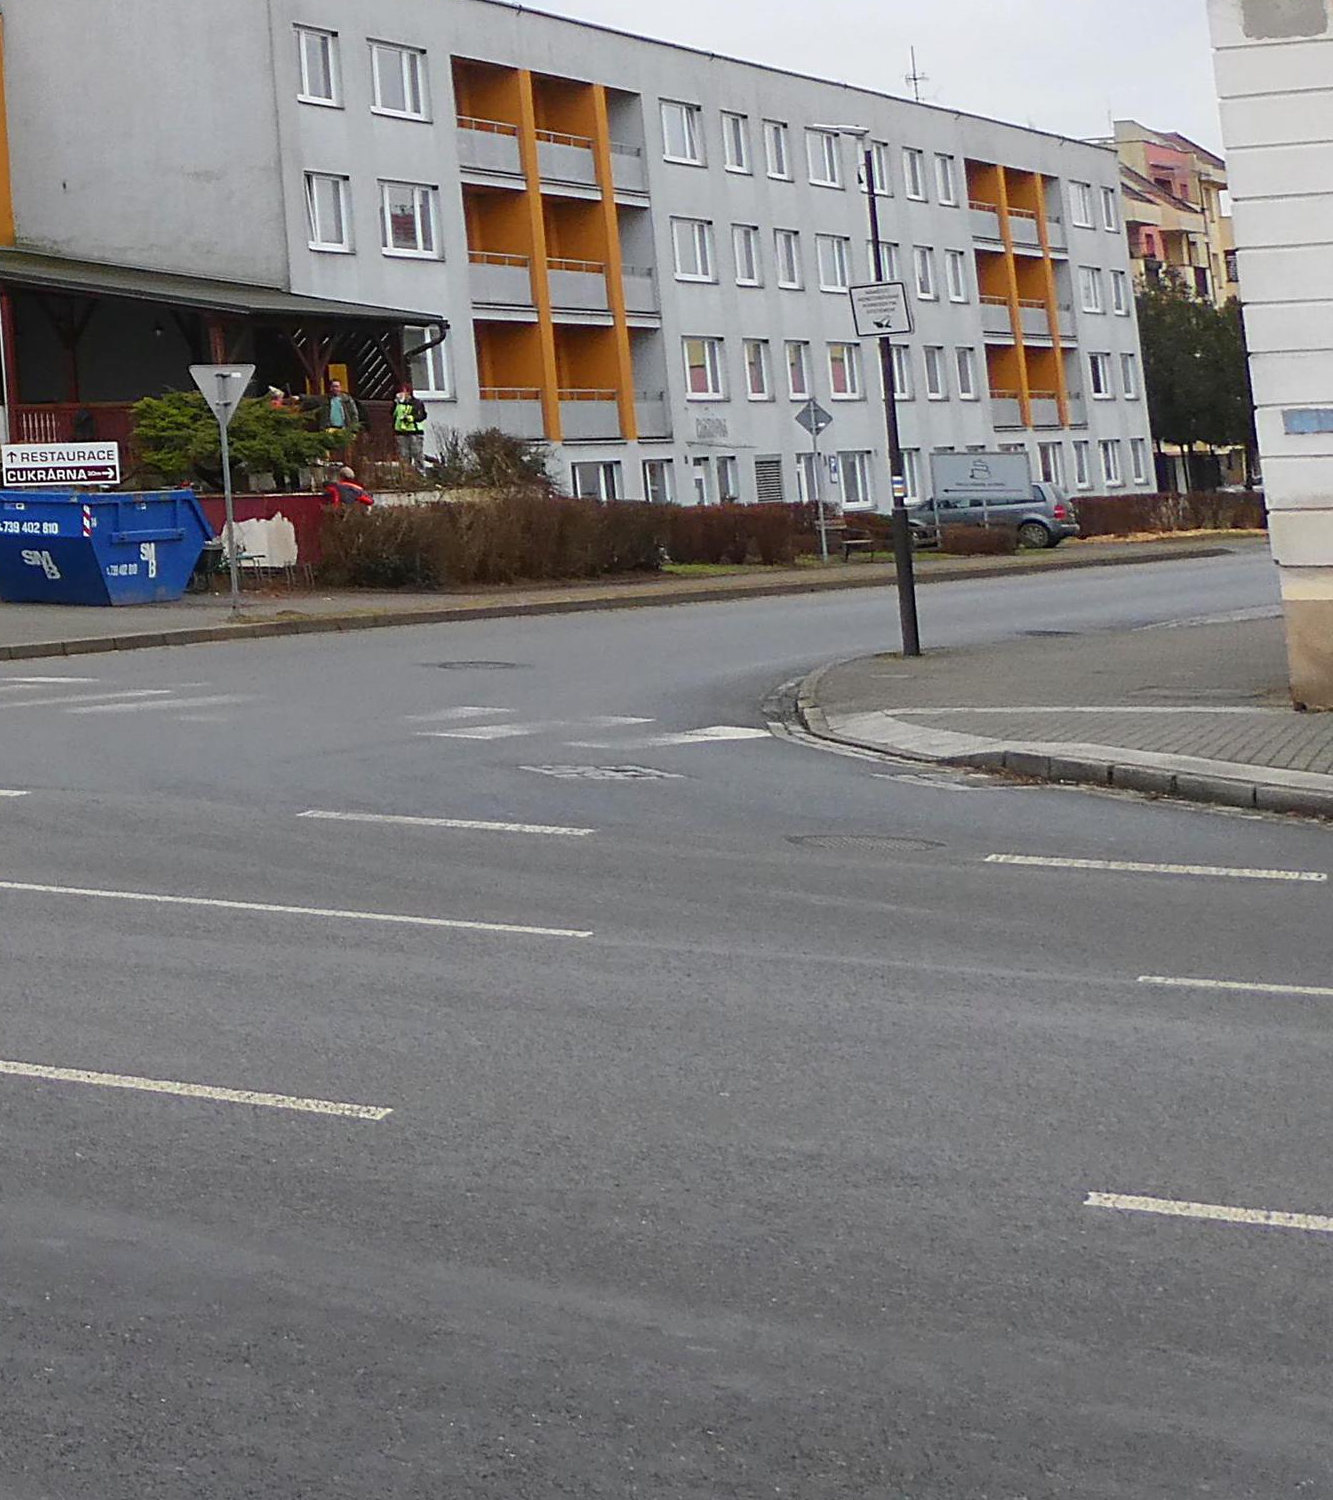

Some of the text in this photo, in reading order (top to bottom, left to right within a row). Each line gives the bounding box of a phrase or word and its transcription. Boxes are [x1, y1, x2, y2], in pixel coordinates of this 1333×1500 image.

[20, 449, 115, 463] RESTAURACE
[7, 468, 88, 482] CUKRÁRNA
[3, 521, 59, 535] 739 402 810
